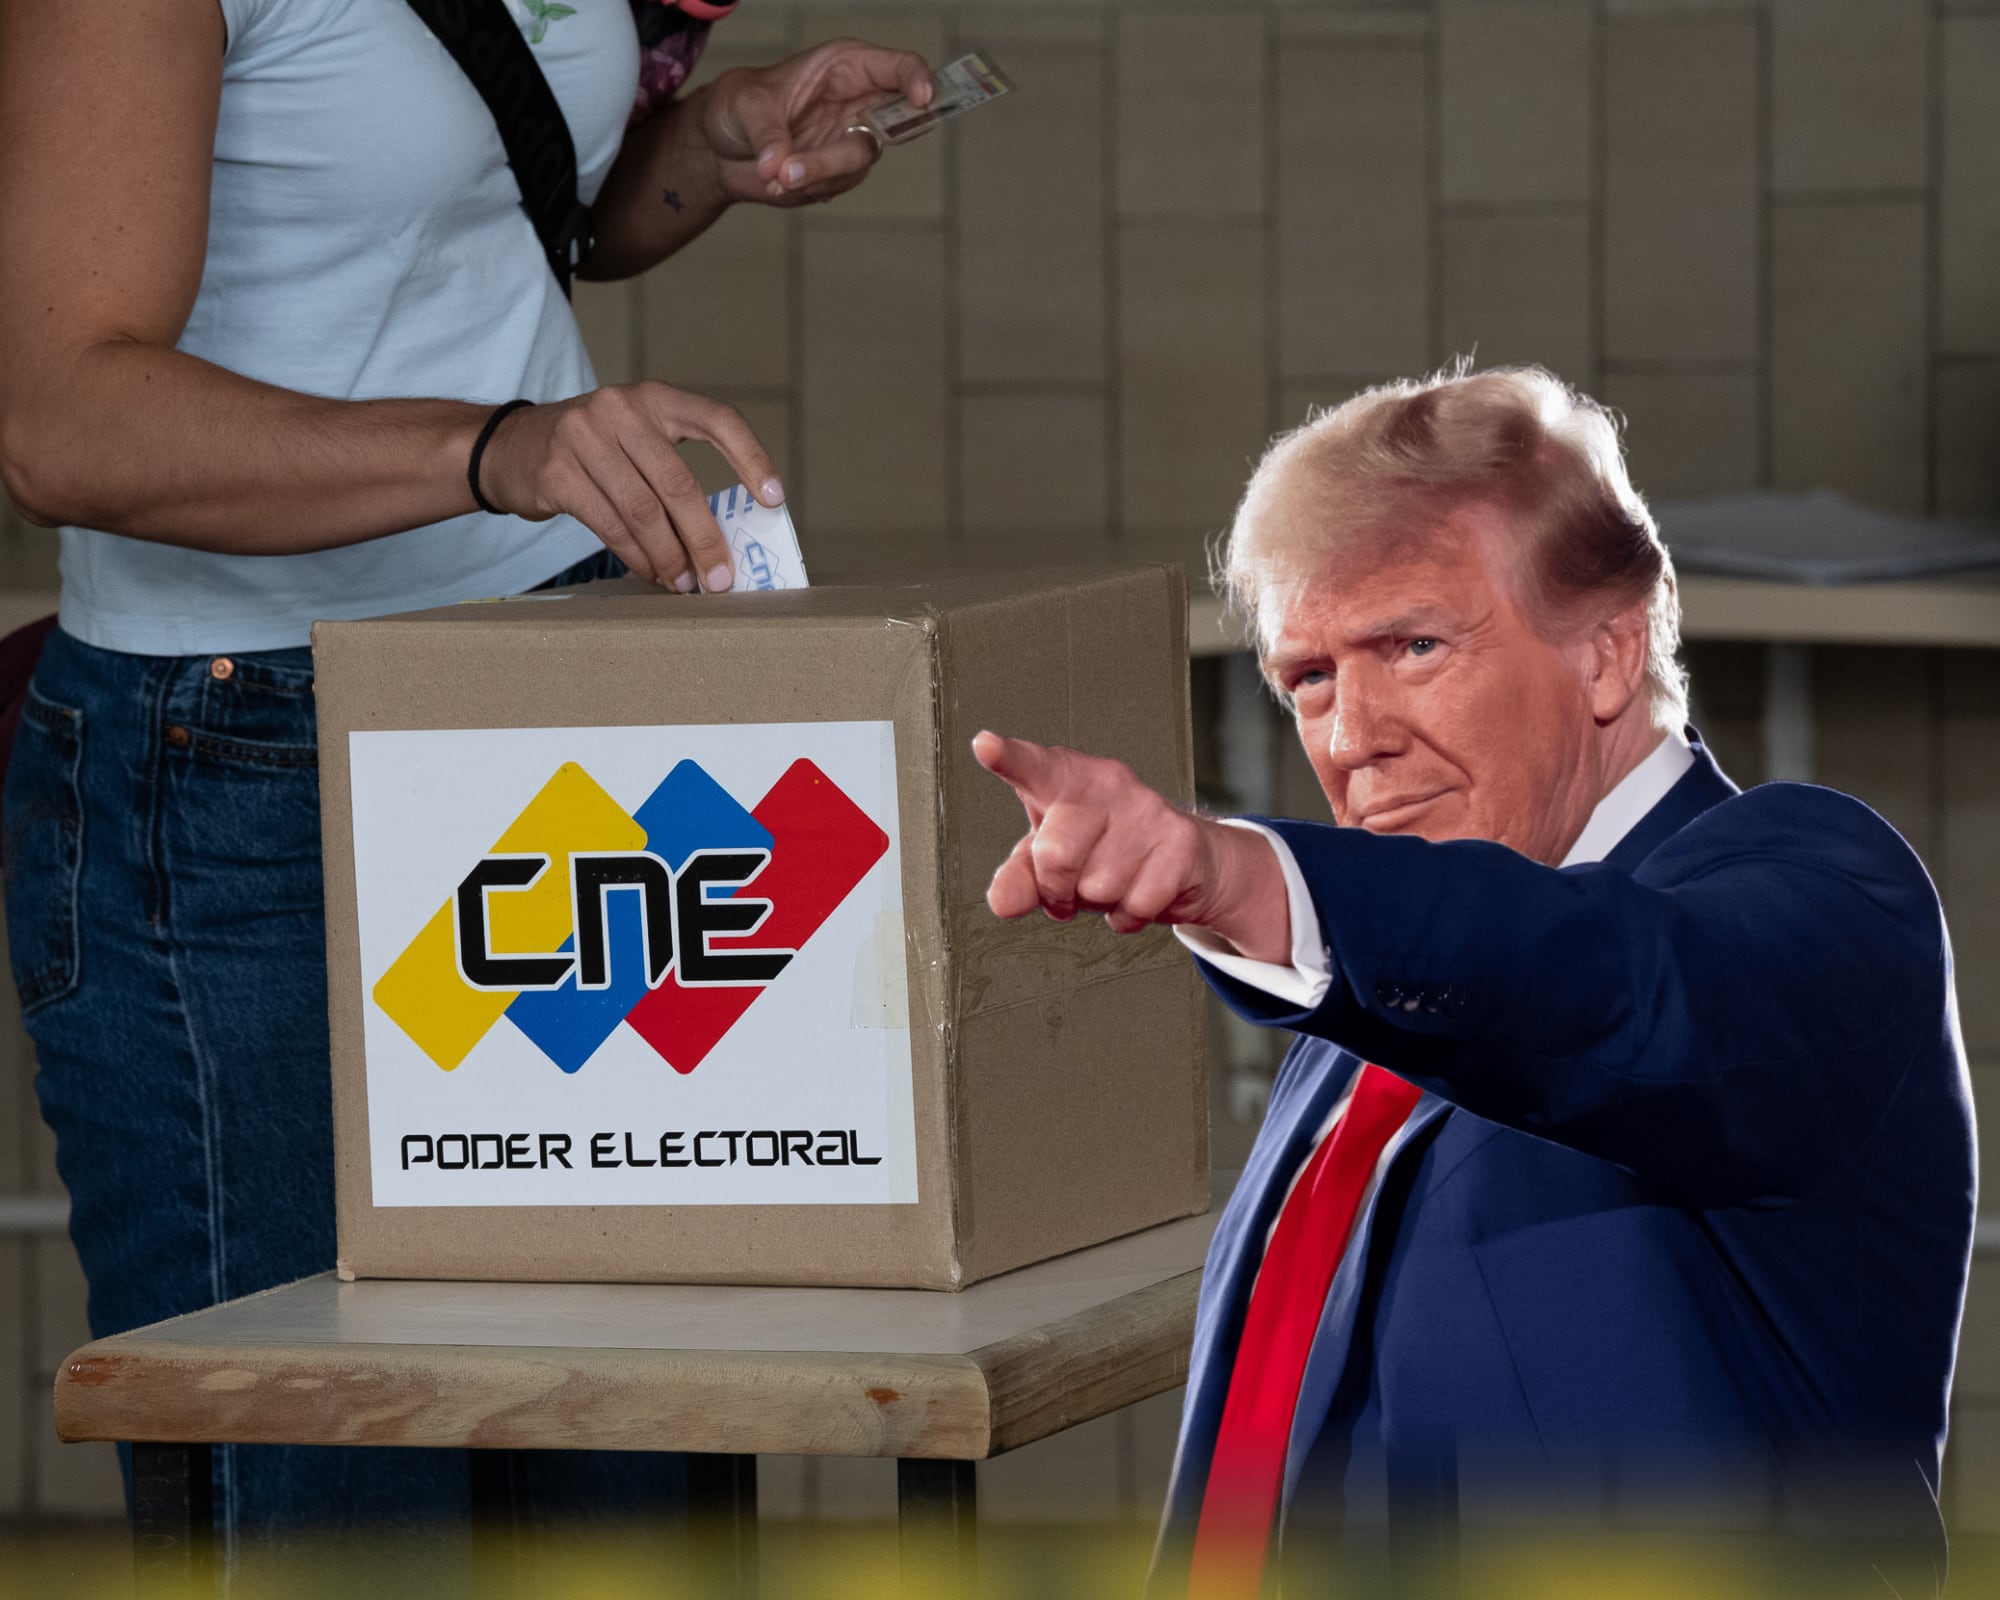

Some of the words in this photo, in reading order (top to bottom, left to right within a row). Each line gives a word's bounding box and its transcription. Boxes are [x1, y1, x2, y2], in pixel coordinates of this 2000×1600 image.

[456, 851, 796, 987] CNE
[401, 1133, 573, 1170] PODER
[590, 1129, 882, 1168] ELECTORAL
